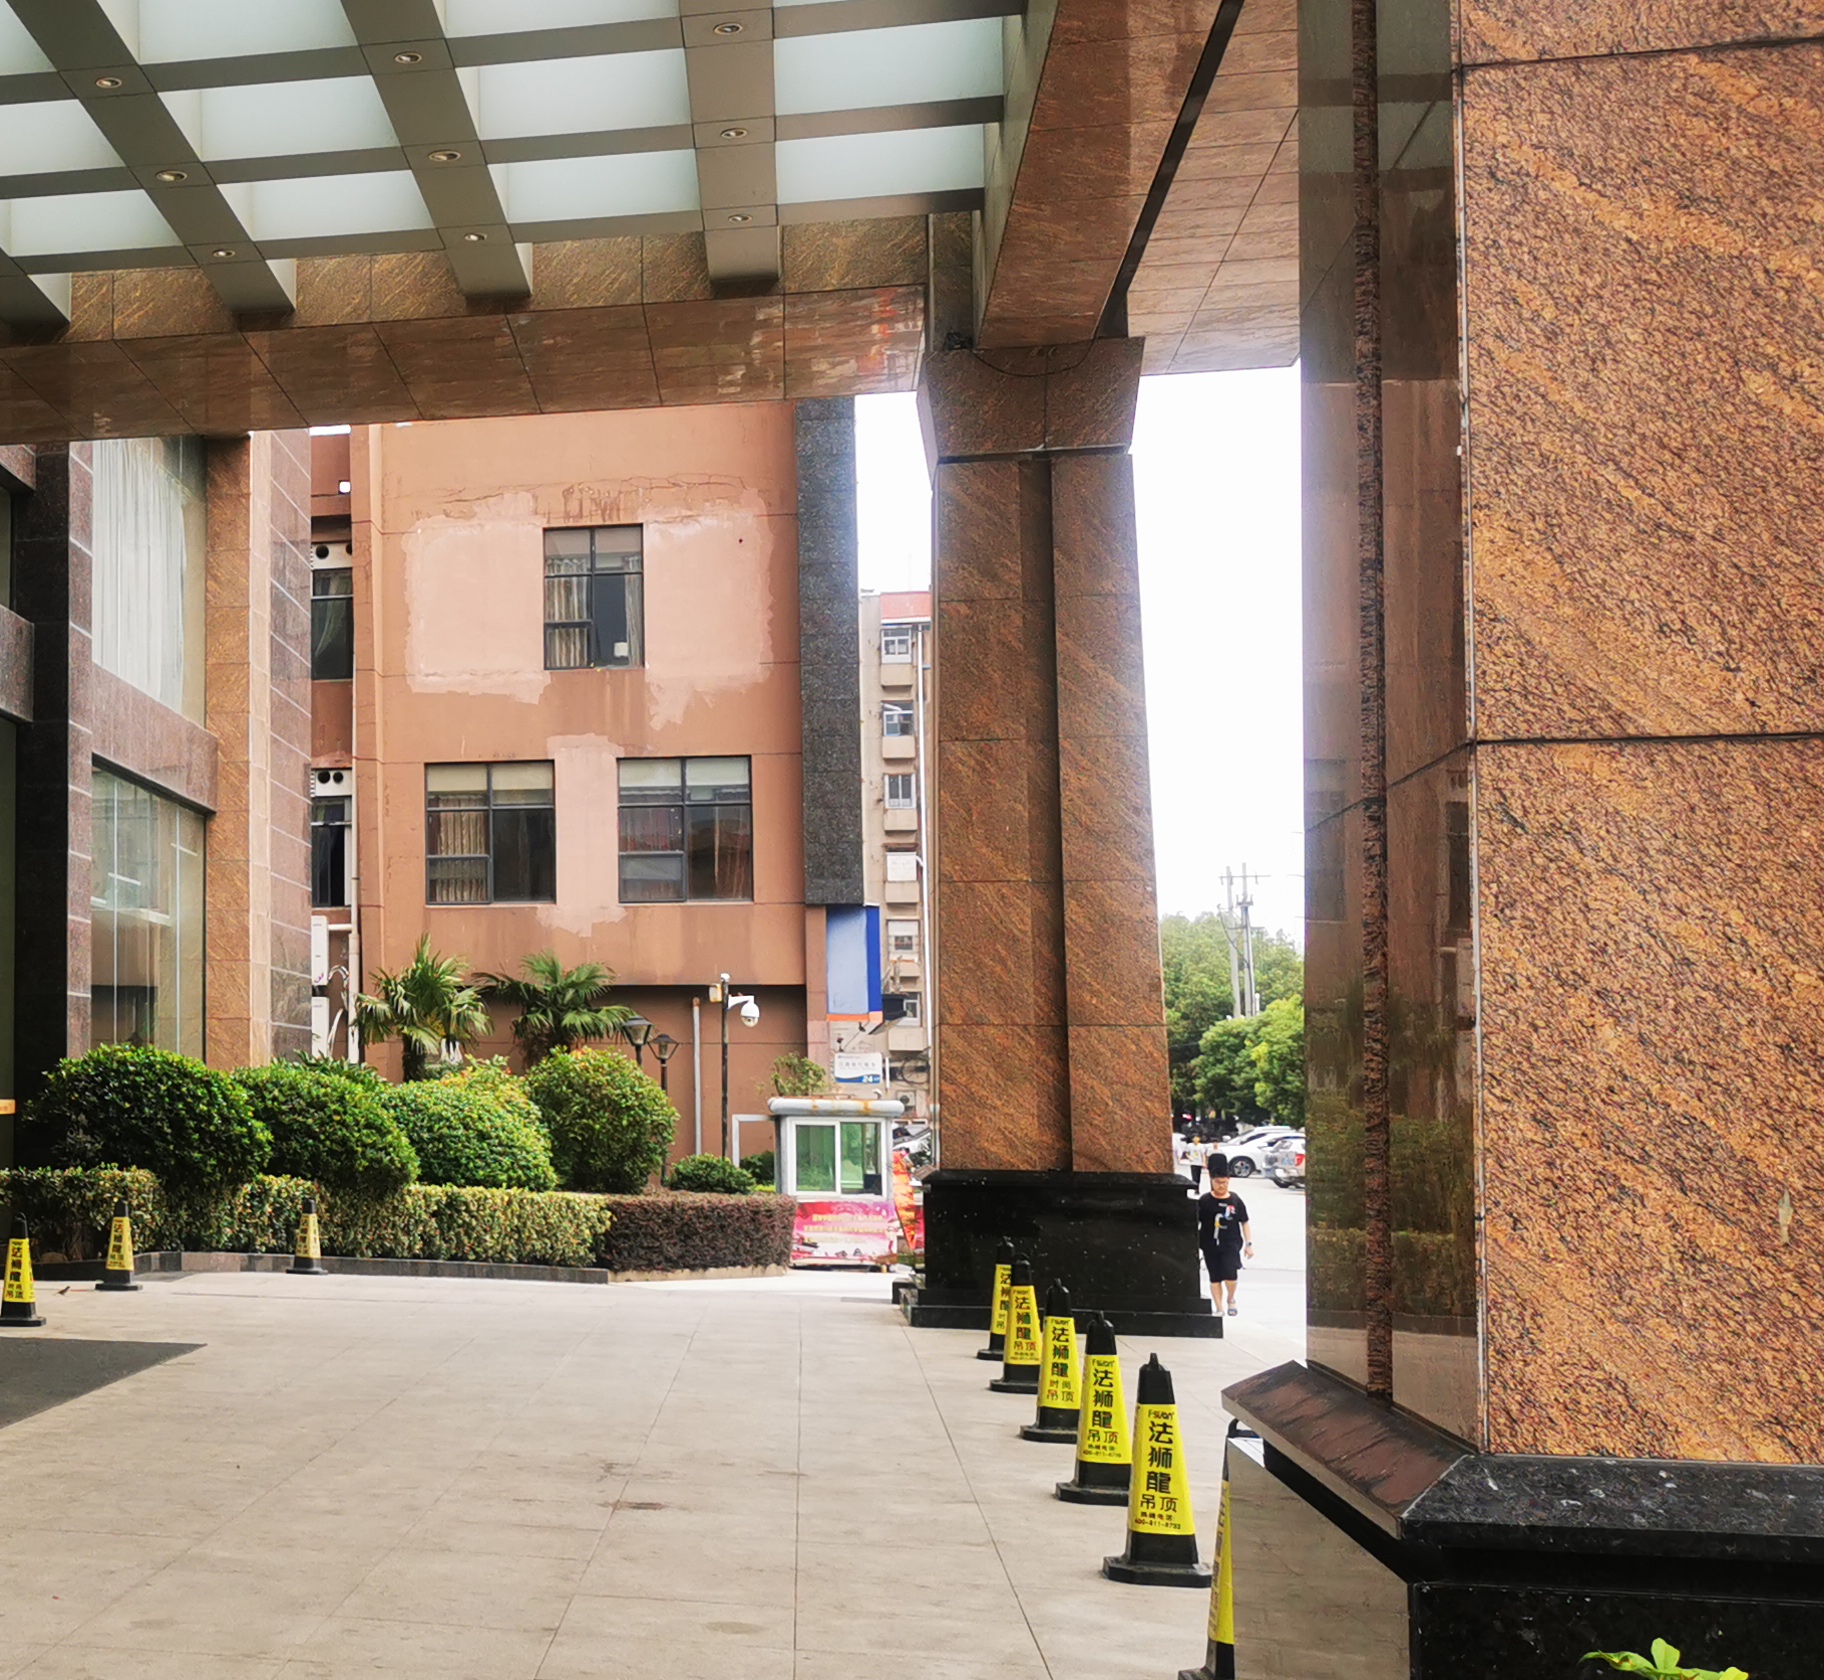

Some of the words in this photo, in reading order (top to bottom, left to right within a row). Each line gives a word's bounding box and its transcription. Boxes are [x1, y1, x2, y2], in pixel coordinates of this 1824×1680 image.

[1047, 1389, 1074, 1403] 吊顶
[1087, 1429, 1119, 1445] 吊顶
[1140, 1494, 1179, 1513] 吊顶
